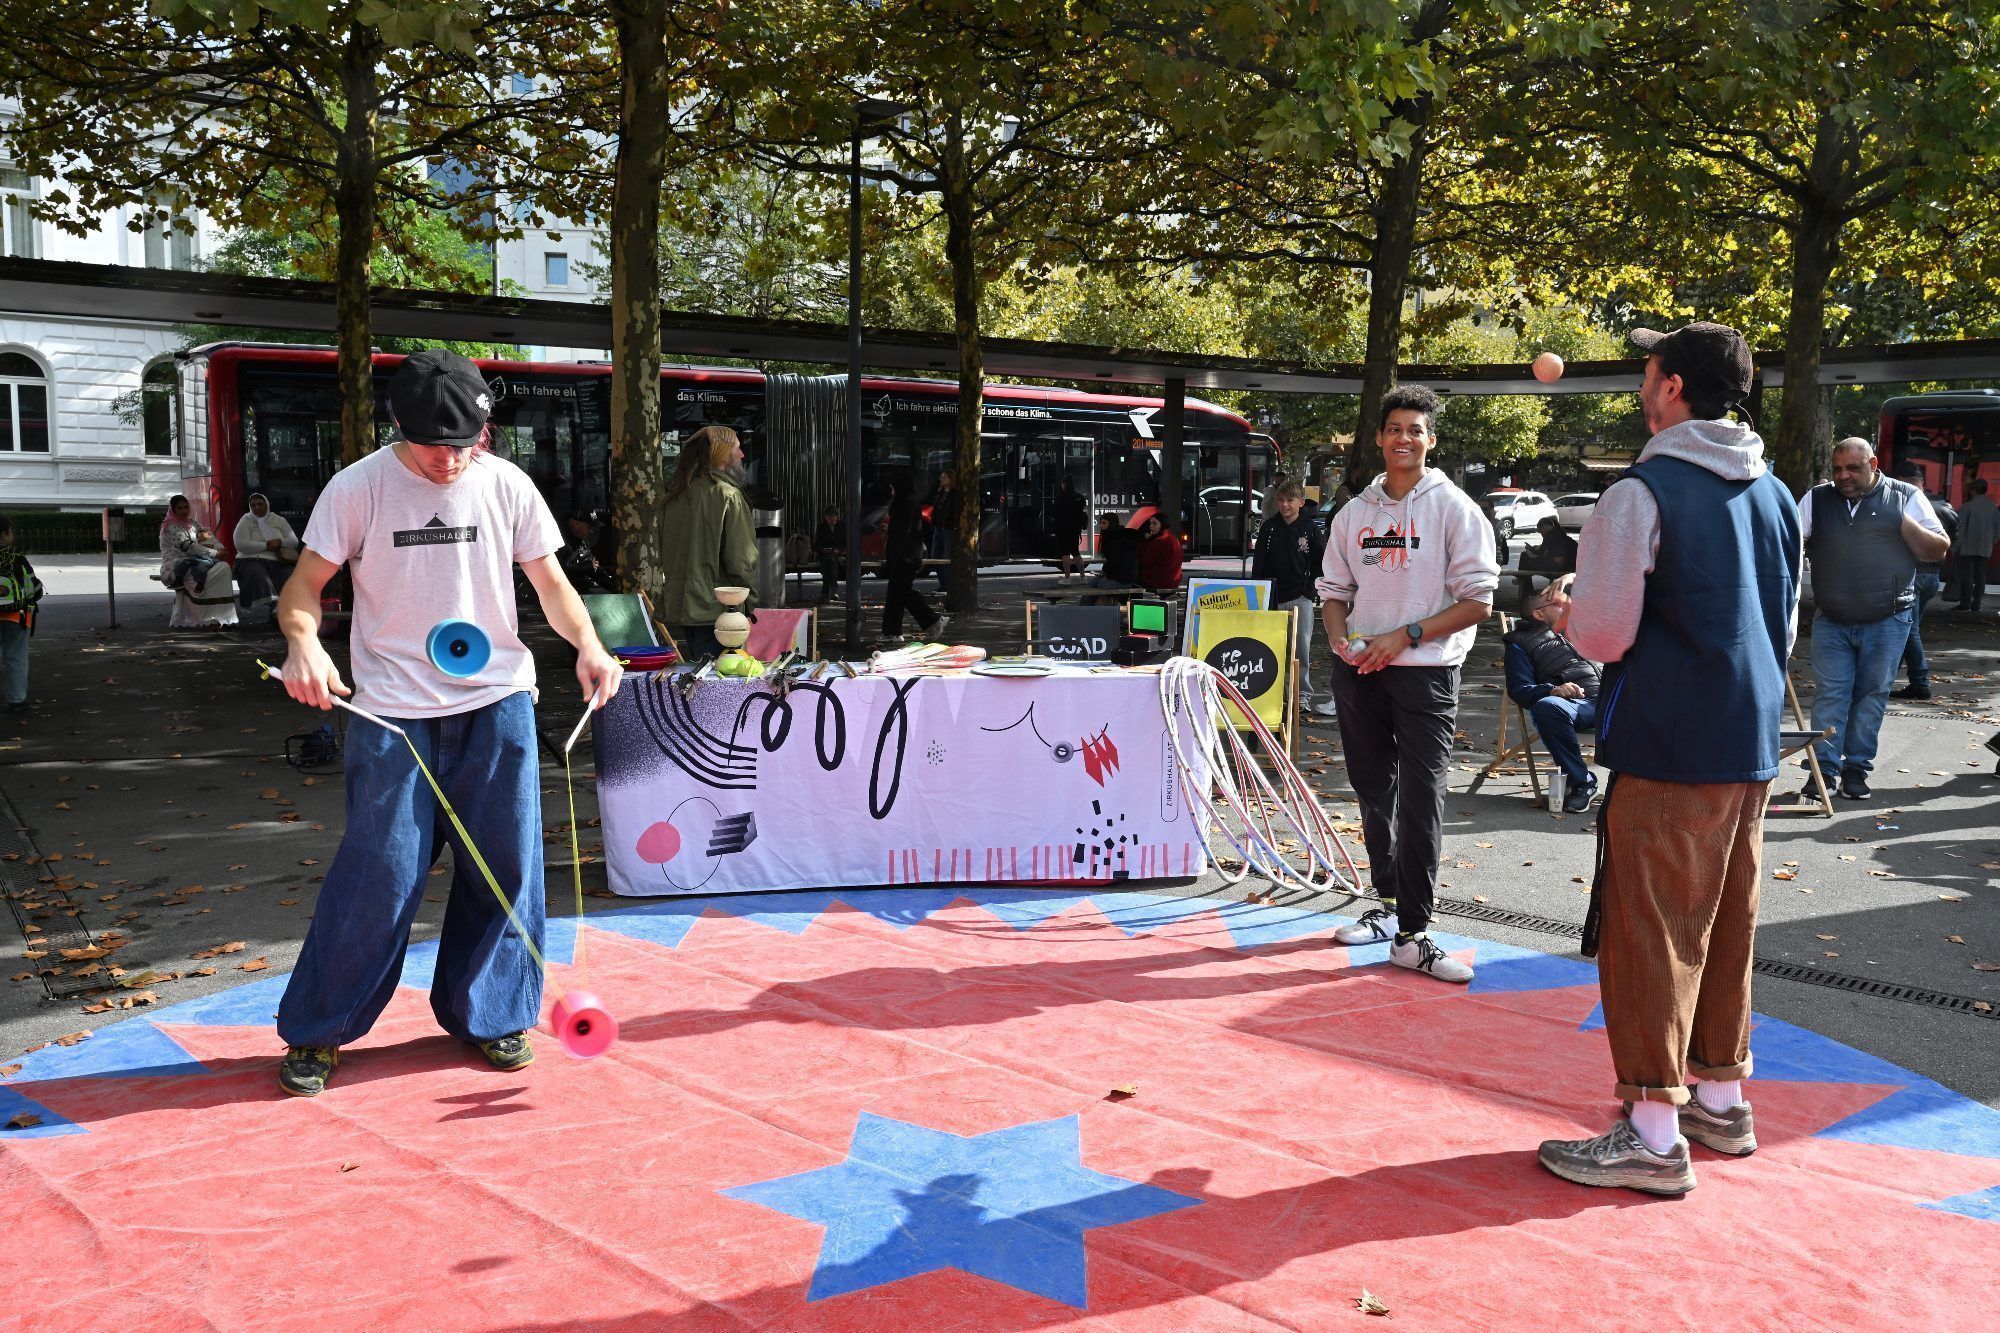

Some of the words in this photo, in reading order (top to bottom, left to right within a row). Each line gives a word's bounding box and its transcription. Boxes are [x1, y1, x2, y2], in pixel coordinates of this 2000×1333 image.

[513, 384, 530, 396] Ich
[532, 385, 561, 397] fahre
[677, 392, 695, 402] das
[697, 393, 727, 403] Klima.
[896, 401, 909, 411] Ich
[910, 403, 930, 412] fahre
[987, 407, 1014, 417] schone
[1015, 409, 1029, 418] das
[1030, 409, 1053, 419] Klima.
[400, 531, 471, 543] ZIRKUSHALLE
[1199, 594, 1229, 607] Kultur
